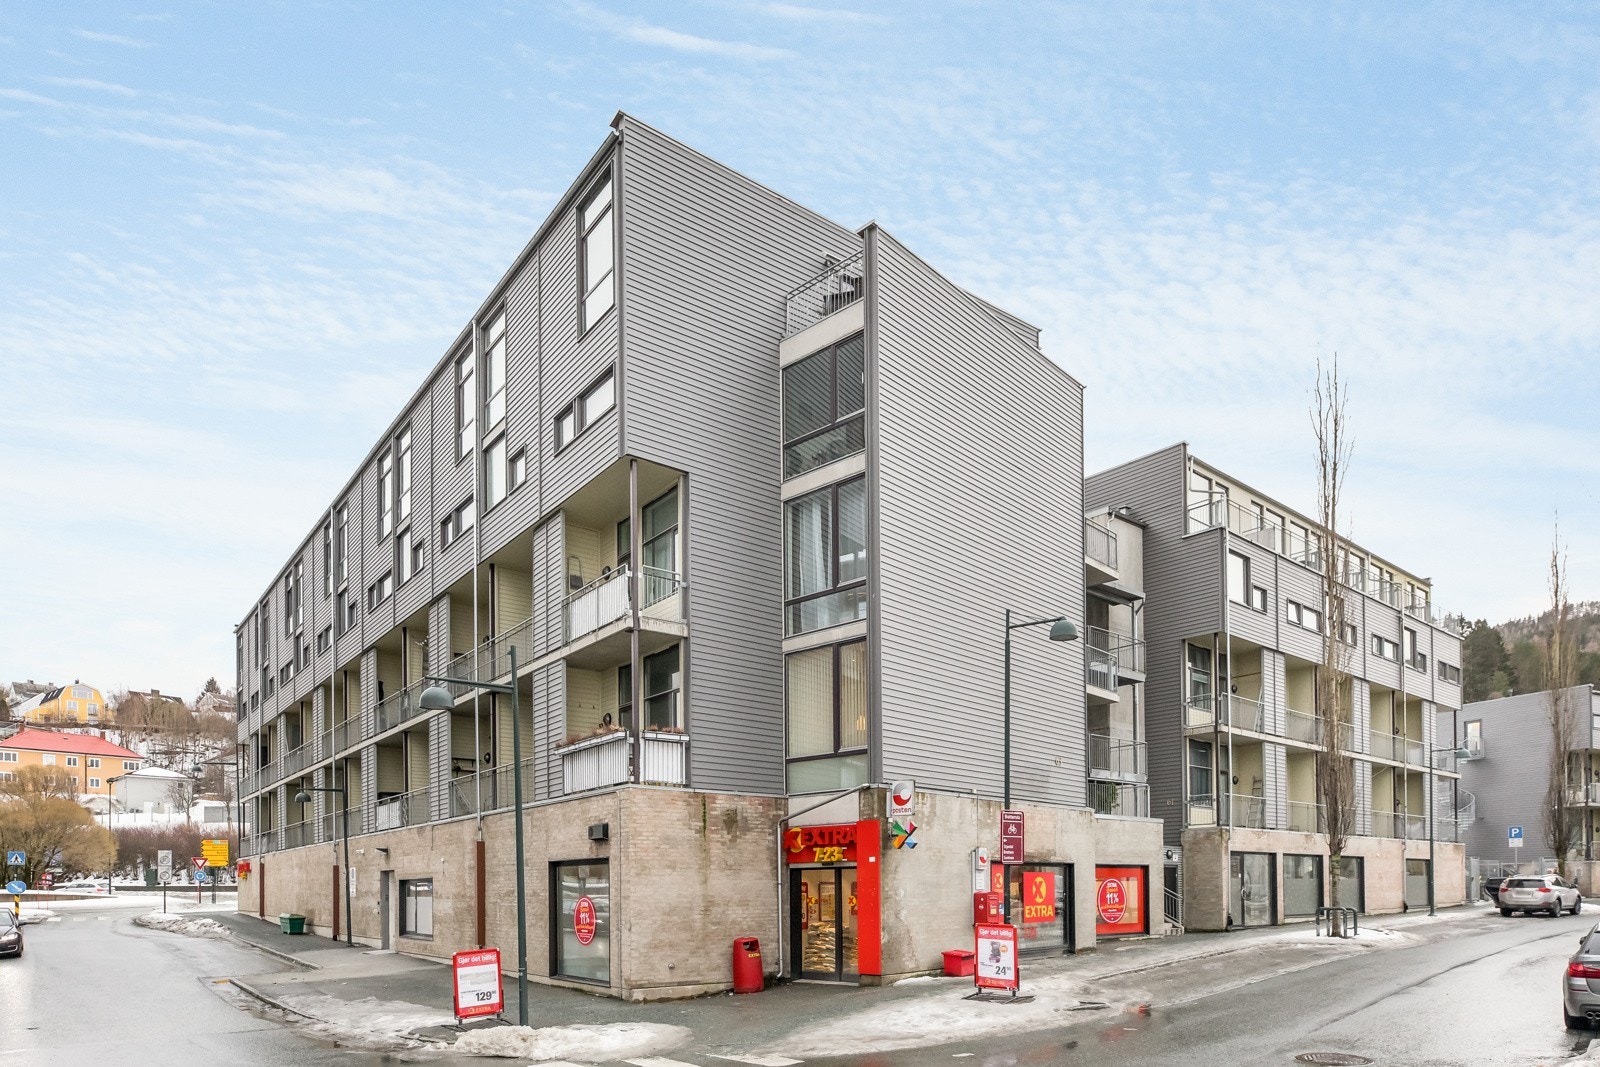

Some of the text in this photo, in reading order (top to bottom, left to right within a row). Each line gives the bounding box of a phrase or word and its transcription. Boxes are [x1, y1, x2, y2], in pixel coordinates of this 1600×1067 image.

[801, 827, 857, 845] EXTRA
[1511, 828, 1519, 837] P
[813, 846, 843, 862] 7-23
[1106, 893, 1120, 904] 11%
[1025, 905, 1053, 918] EXTRA
[458, 957, 470, 965] Gjør
[995, 965, 1007, 976] 24
[475, 990, 492, 1002] 129
